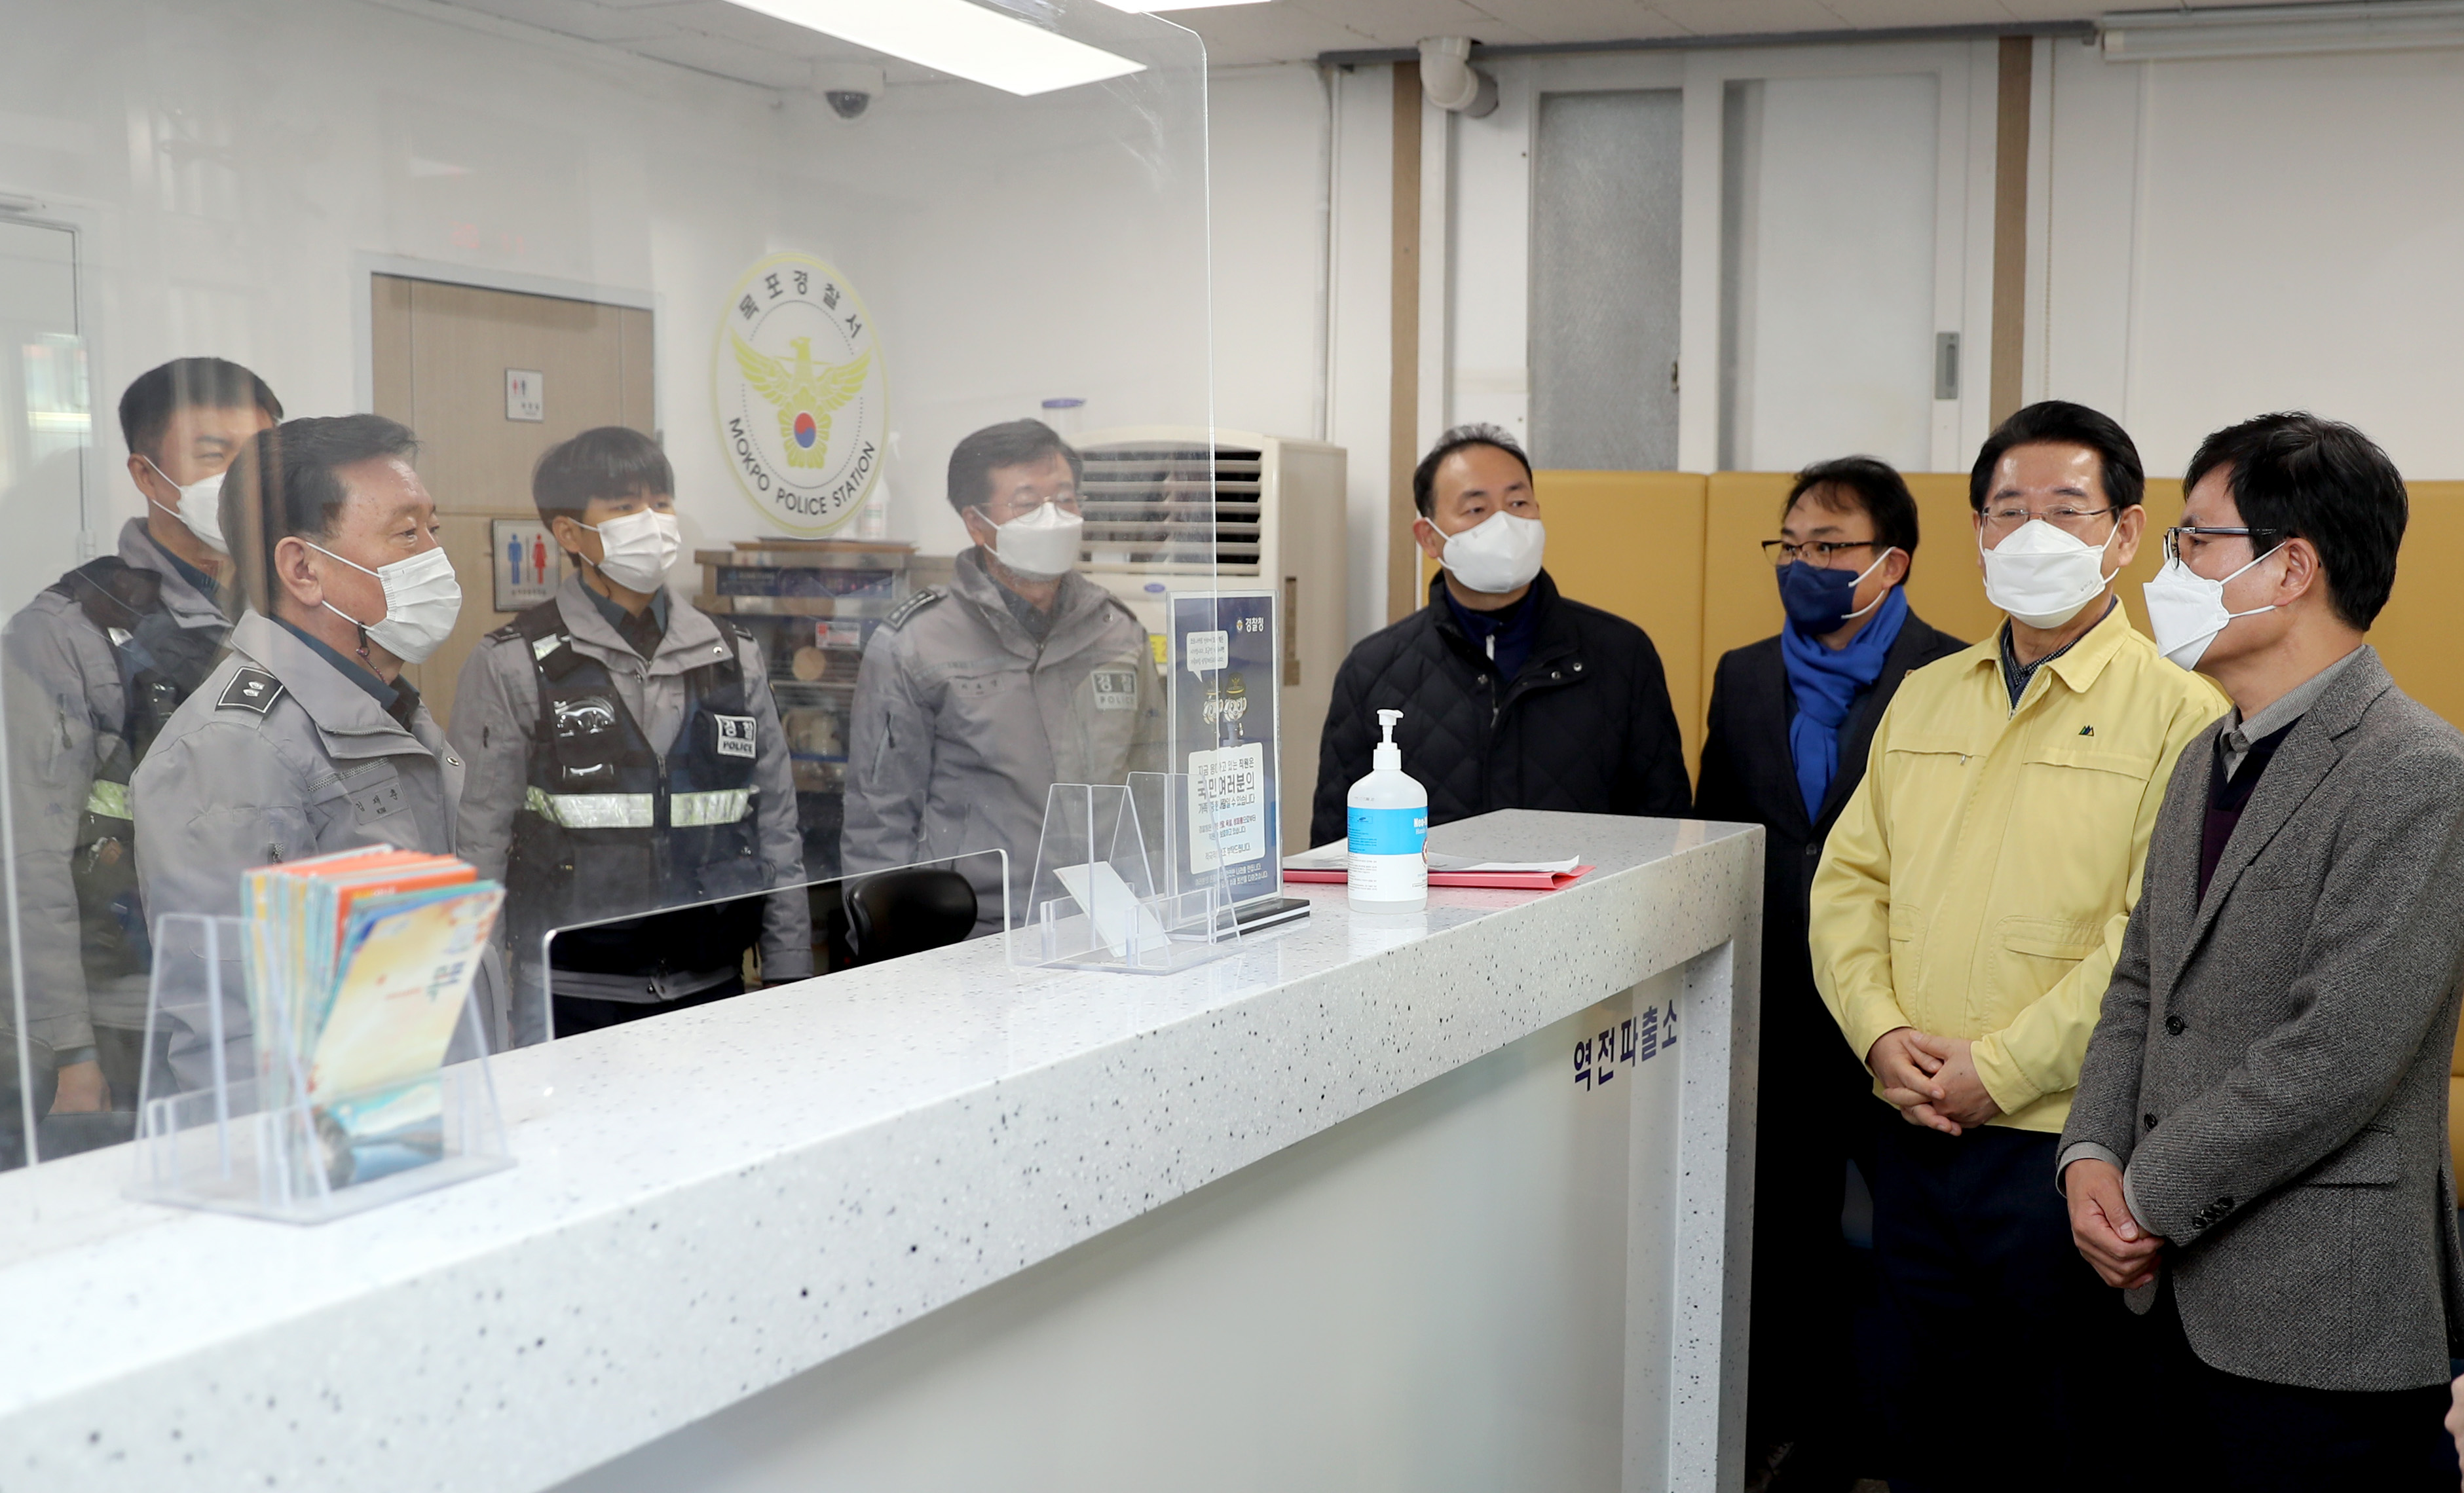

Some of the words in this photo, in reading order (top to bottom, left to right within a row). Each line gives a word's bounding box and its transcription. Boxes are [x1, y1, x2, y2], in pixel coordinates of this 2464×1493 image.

[739, 270, 862, 339] 목포경찰서
[729, 417, 770, 491] MOKPO
[775, 487, 827, 515] POLICE
[832, 441, 875, 507] STATION
[1245, 617, 1264, 633] 경찰청
[723, 741, 753, 752] POLICE
[1239, 756, 1254, 769] 직원은
[1574, 999, 1677, 1092] 역전파출소
